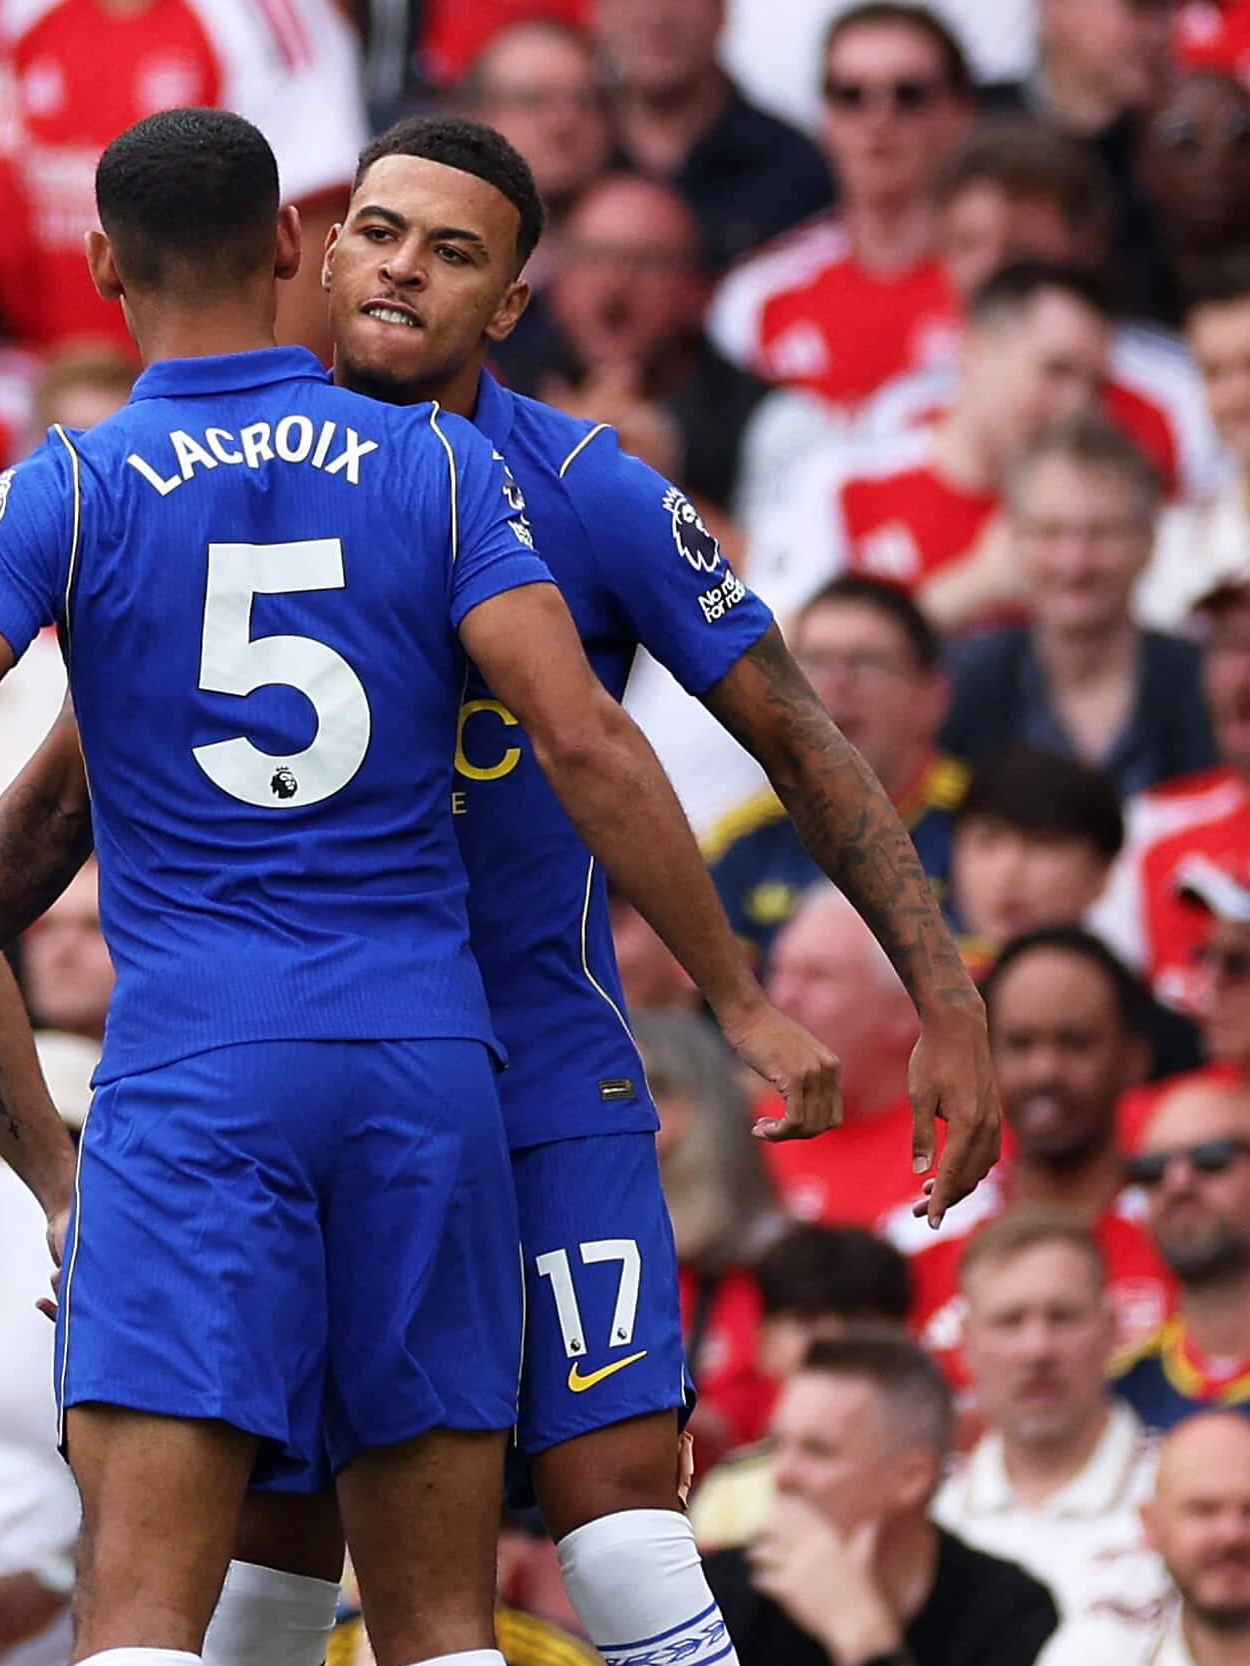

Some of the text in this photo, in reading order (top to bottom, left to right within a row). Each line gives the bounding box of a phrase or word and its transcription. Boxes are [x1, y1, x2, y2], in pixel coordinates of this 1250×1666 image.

[126, 414, 380, 497] LACROIX
[698, 589, 722, 610] No
[191, 537, 372, 808] 5
[535, 1239, 641, 1358] 17
